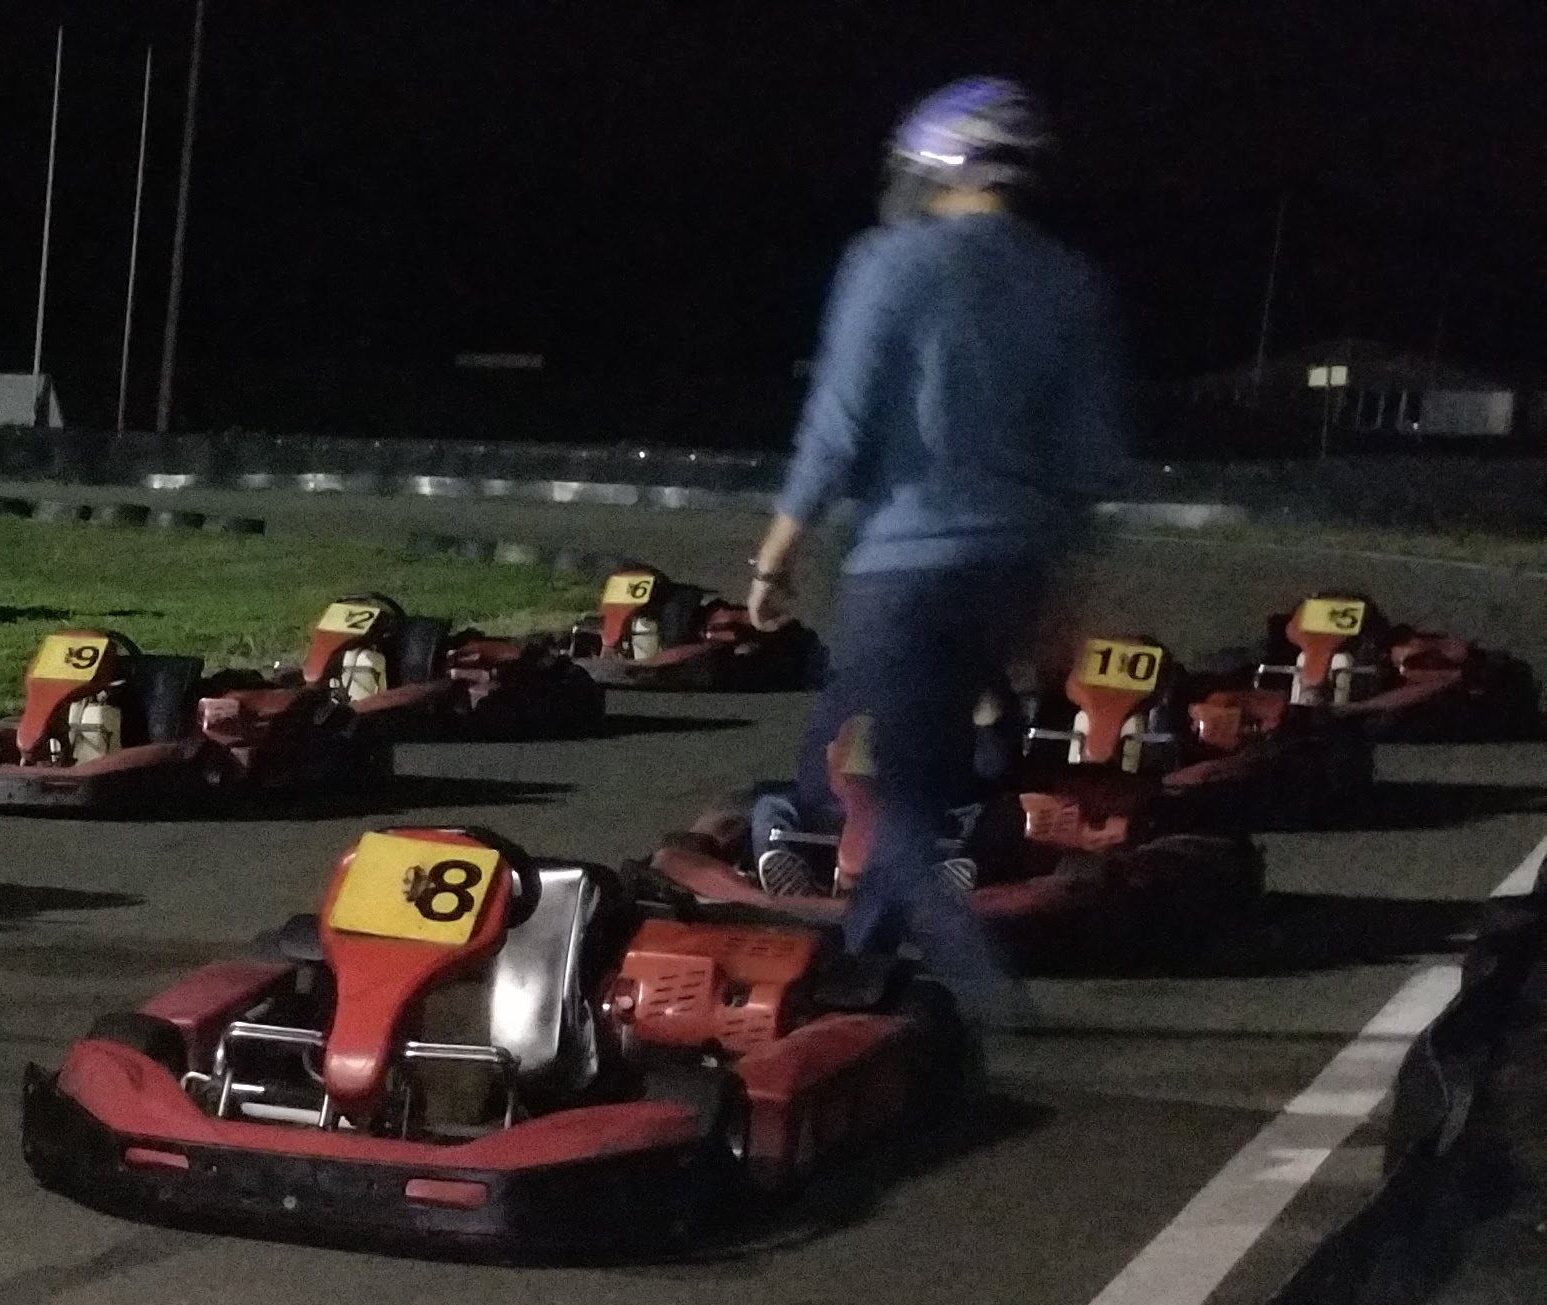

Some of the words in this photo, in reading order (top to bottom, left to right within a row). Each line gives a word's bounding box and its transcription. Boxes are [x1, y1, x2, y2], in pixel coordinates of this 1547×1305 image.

[631, 581, 650, 599] 6
[346, 610, 375, 629] 2
[71, 646, 100, 669] 9
[1093, 647, 1157, 680] 10
[414, 859, 483, 922] 8
